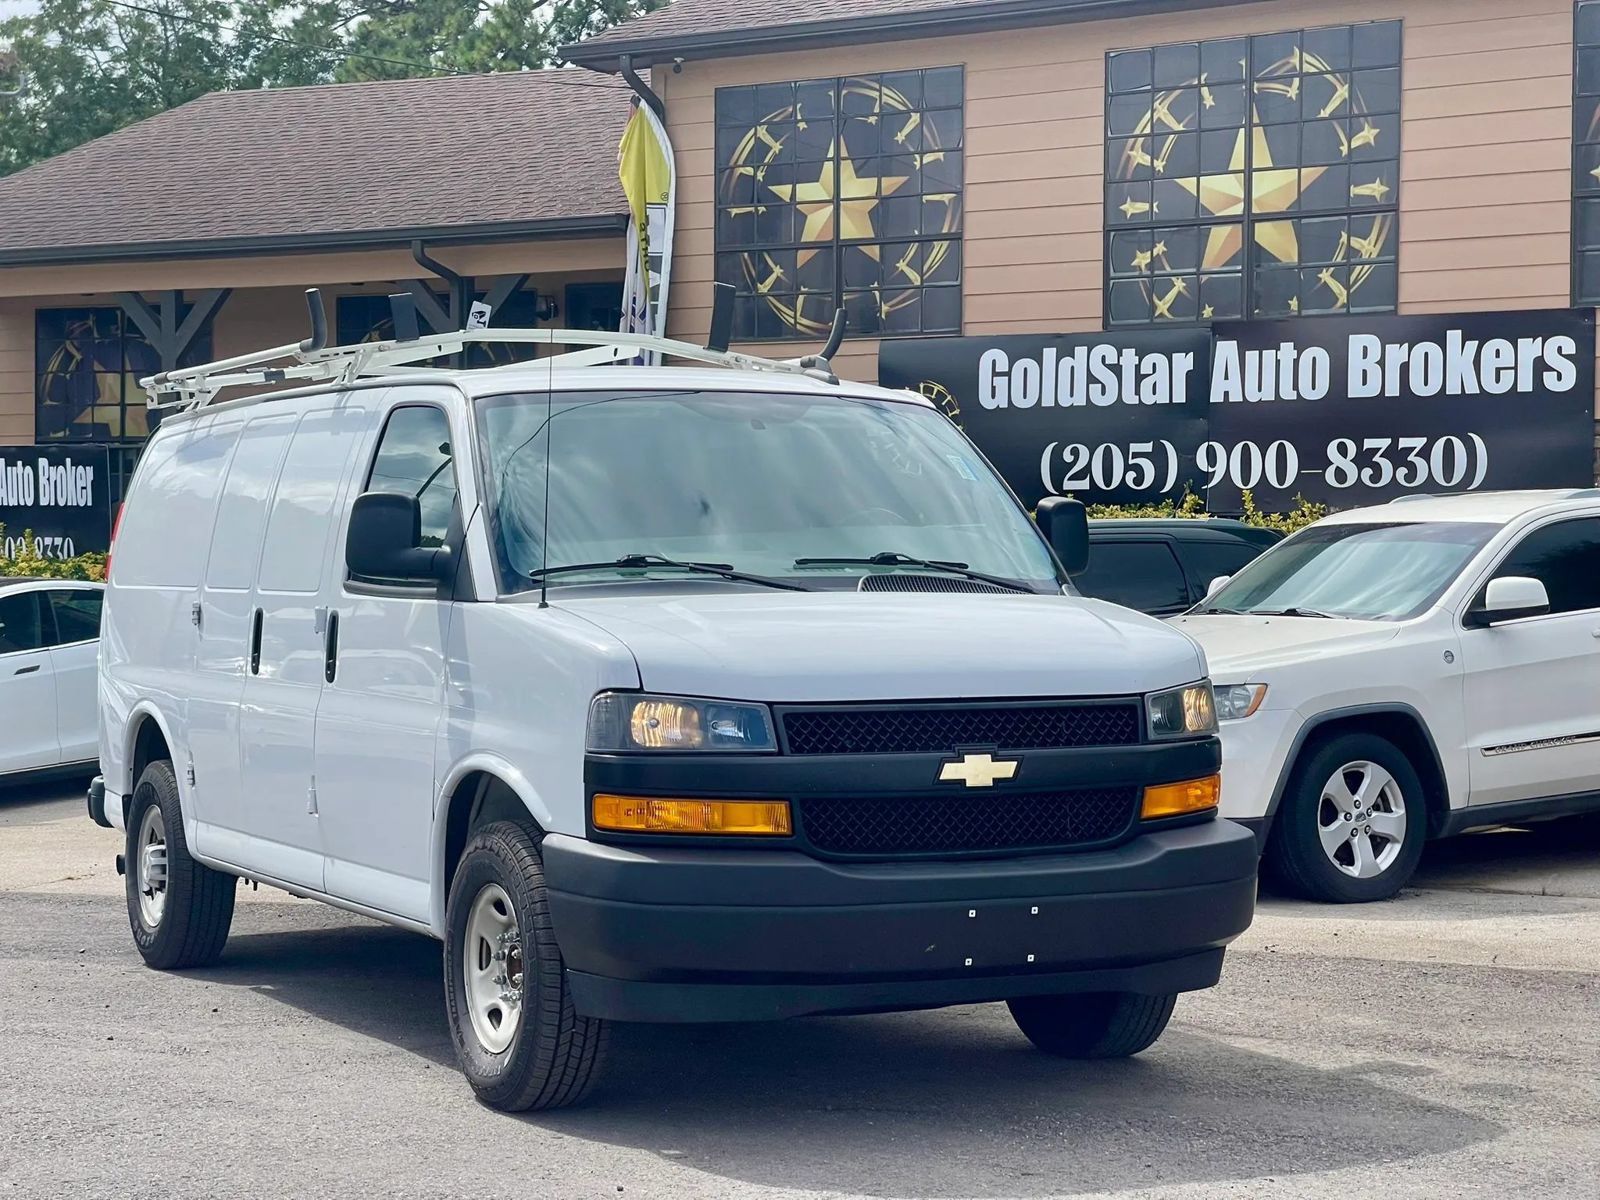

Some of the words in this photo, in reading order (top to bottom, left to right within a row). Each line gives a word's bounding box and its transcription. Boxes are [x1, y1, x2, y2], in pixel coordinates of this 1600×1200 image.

[978, 343, 1194, 411] GoldStar
[1209, 340, 1330, 403] Auto
[1347, 329, 1577, 399] Brokers
[0, 458, 35, 507] Auto
[38, 457, 94, 507] Broker
[1039, 439, 1179, 495] (205)
[1195, 432, 1489, 491] 900-8330)
[1495, 742, 1528, 754] GRAND
[1530, 735, 1577, 750] CHEROKEE
